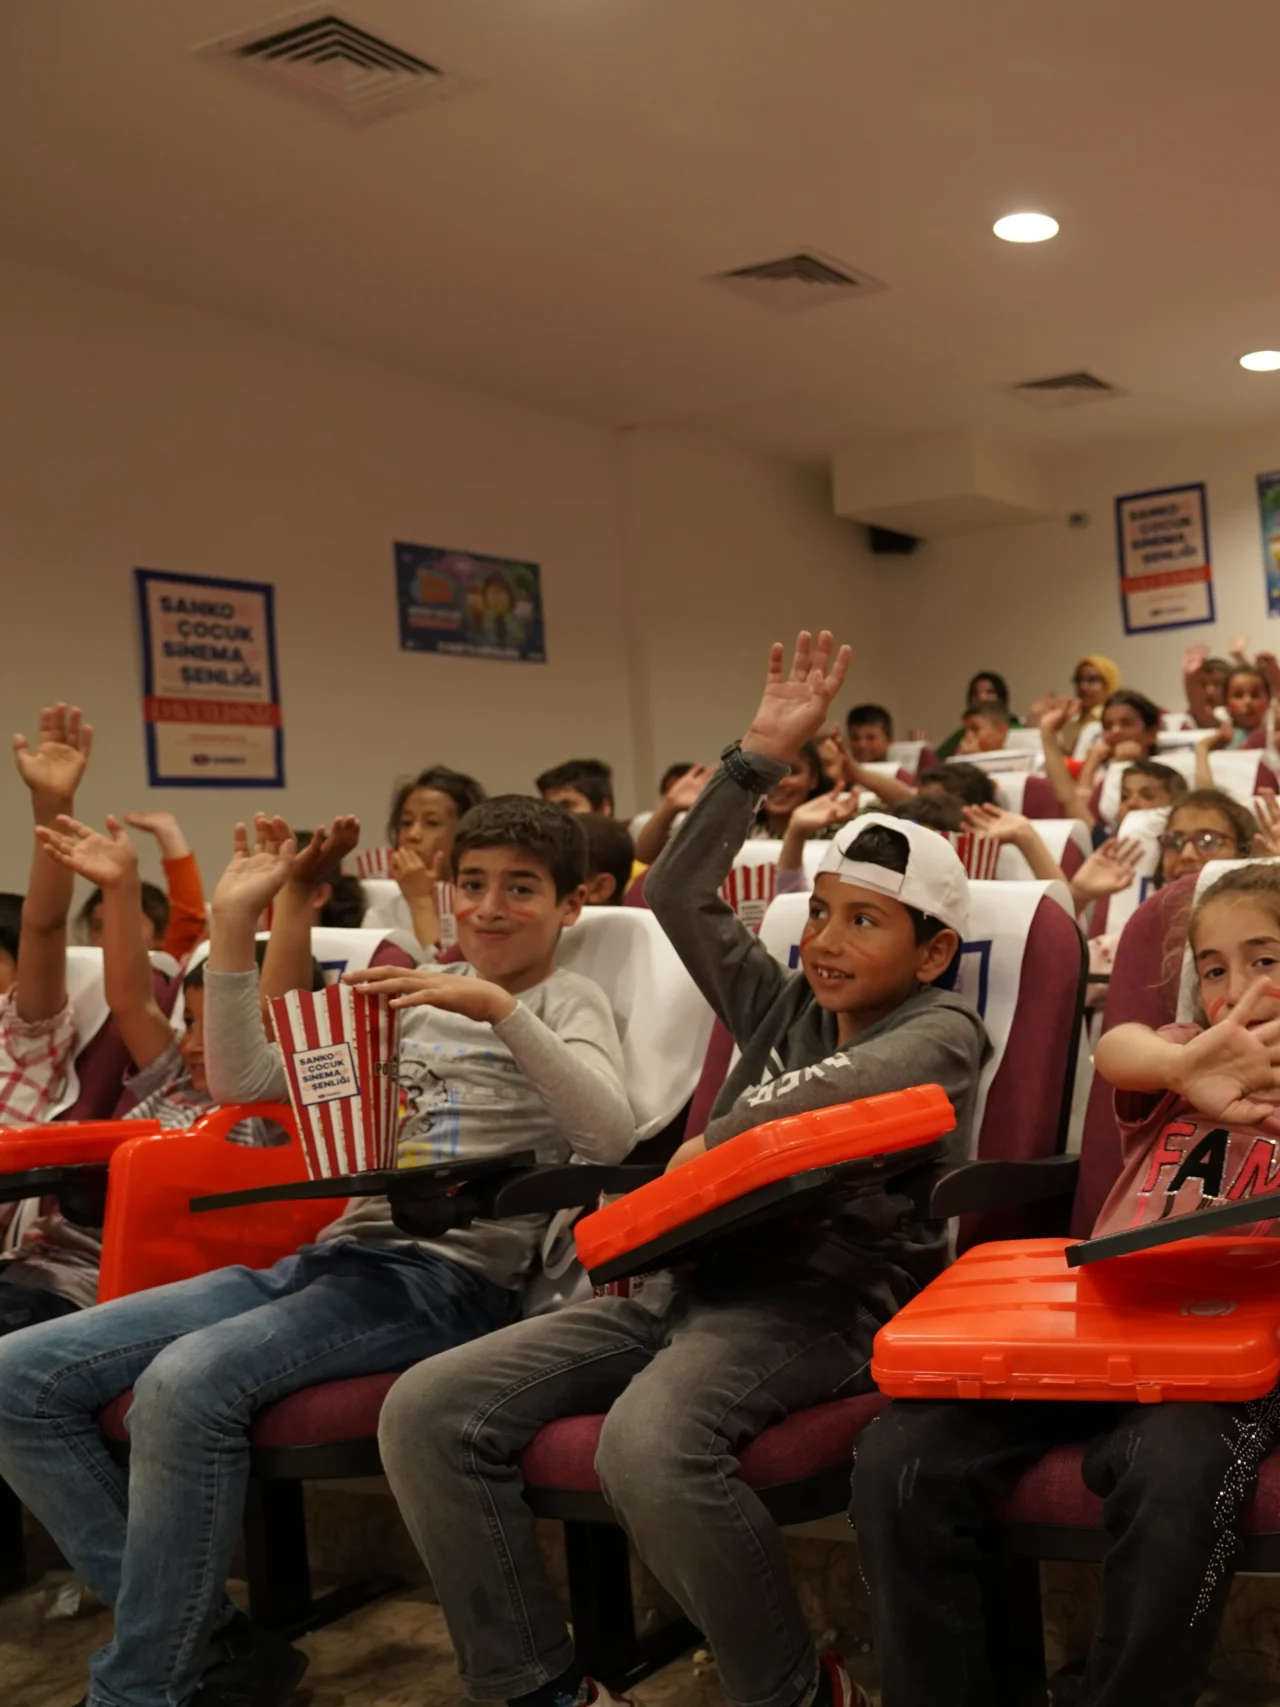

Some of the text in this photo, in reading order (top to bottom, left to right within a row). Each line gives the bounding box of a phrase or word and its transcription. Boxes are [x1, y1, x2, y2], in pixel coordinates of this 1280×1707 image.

[160, 595, 234, 619] SANKO
[177, 620, 254, 642] ÇOCUK
[299, 1053, 334, 1066] SANKO
[308, 1059, 345, 1074] ÇOCUK
